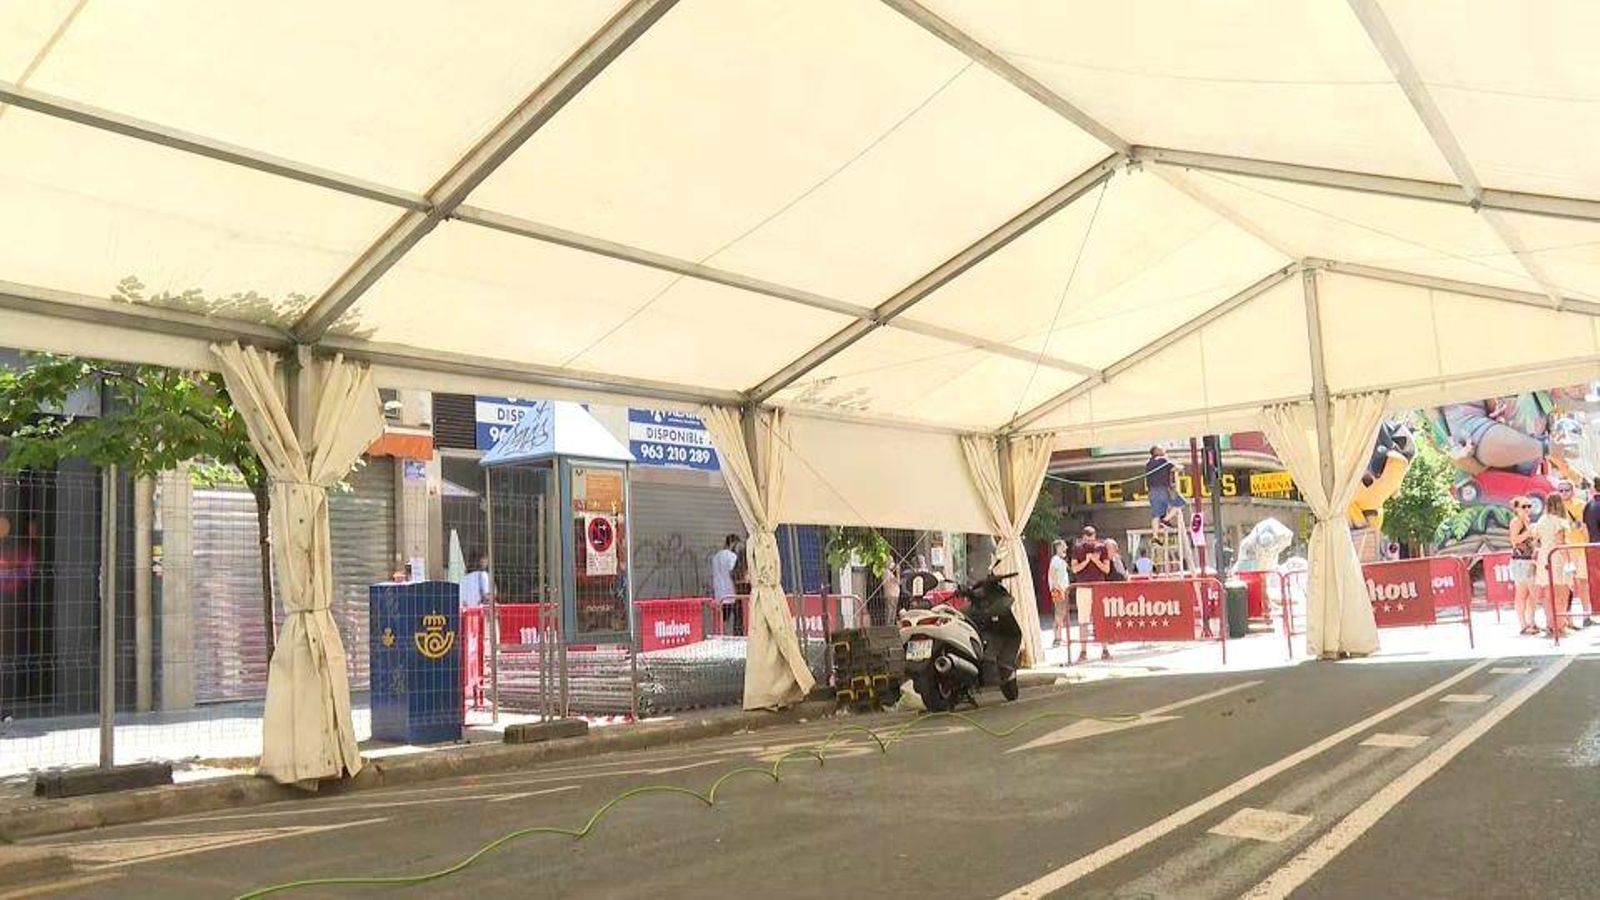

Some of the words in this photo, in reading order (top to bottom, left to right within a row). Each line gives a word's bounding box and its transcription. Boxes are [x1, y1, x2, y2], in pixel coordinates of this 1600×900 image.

[646, 427, 704, 445] DISPONIBLE
[640, 443, 664, 460] 963
[667, 445, 687, 461] 210
[689, 447, 711, 464] 289
[1102, 594, 1181, 617] Mahou
[654, 619, 691, 637] Mahou
